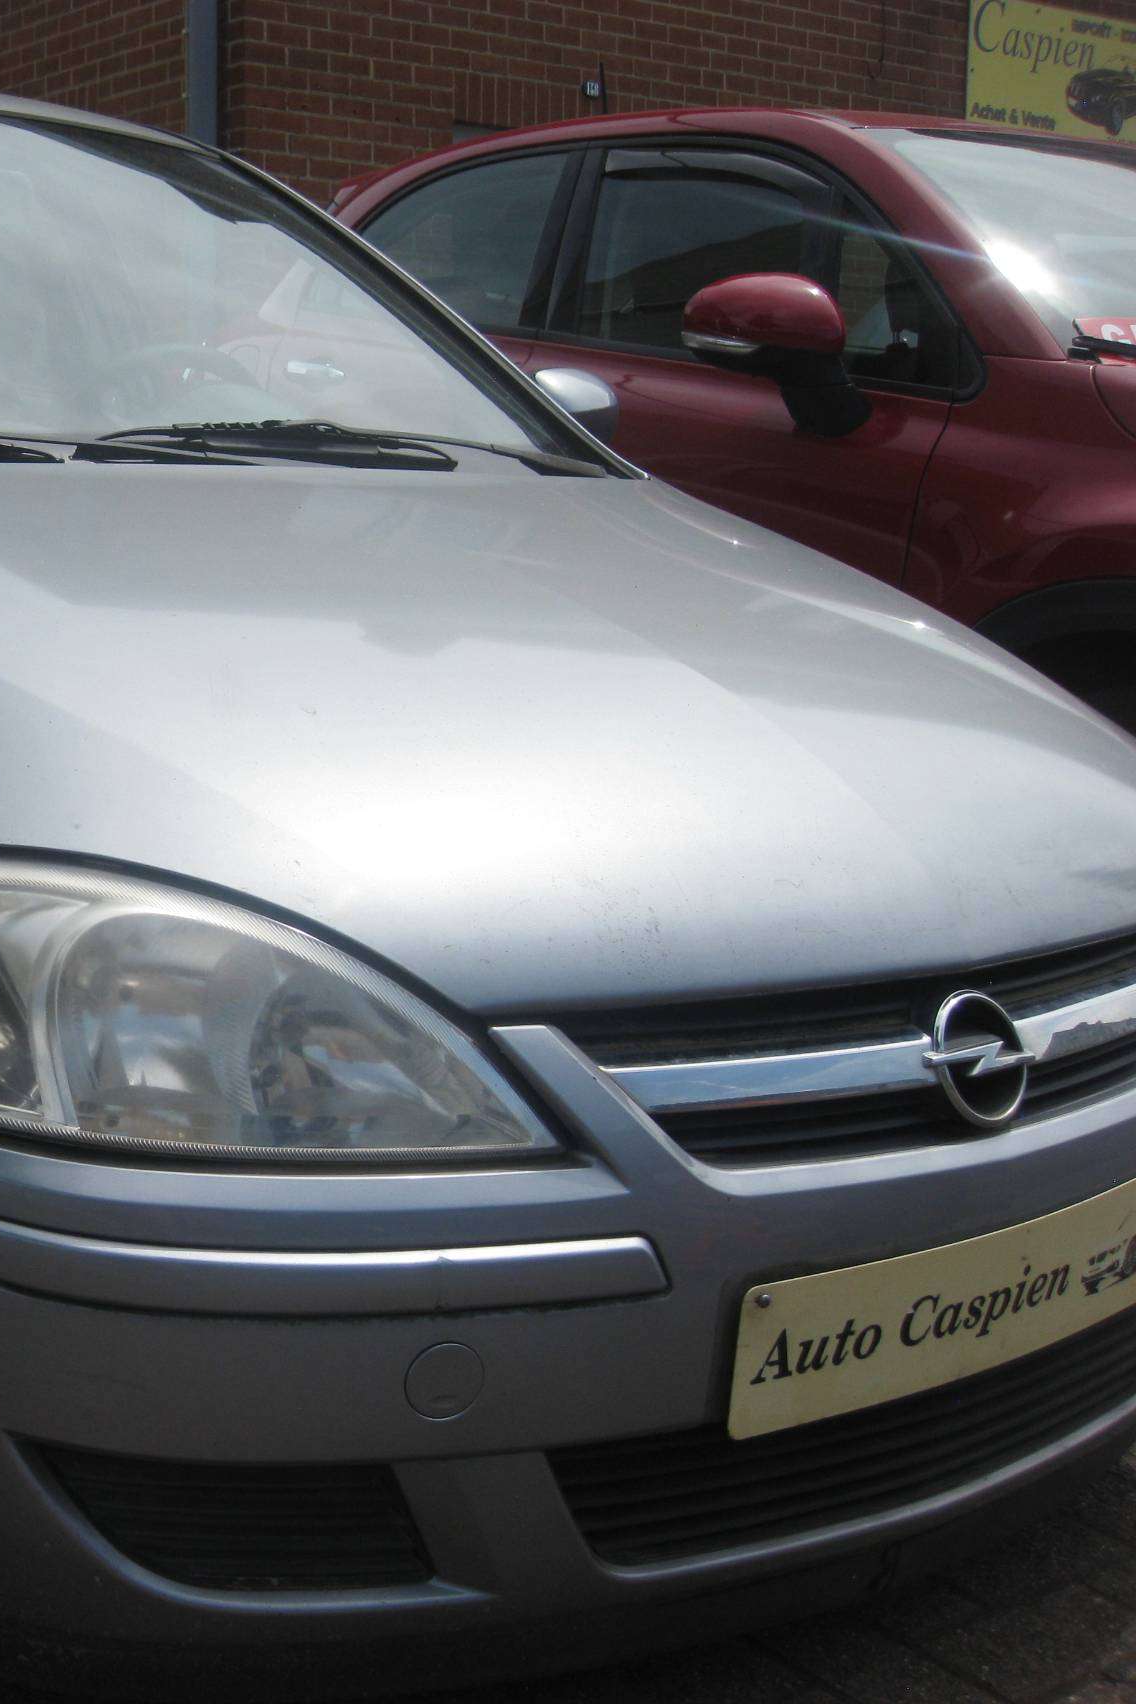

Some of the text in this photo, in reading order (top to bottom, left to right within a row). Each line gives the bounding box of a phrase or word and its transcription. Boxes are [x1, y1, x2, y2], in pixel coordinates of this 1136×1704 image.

[974, 0, 1095, 73] Caspien
[750, 1264, 1070, 1385] Auto Caspien
